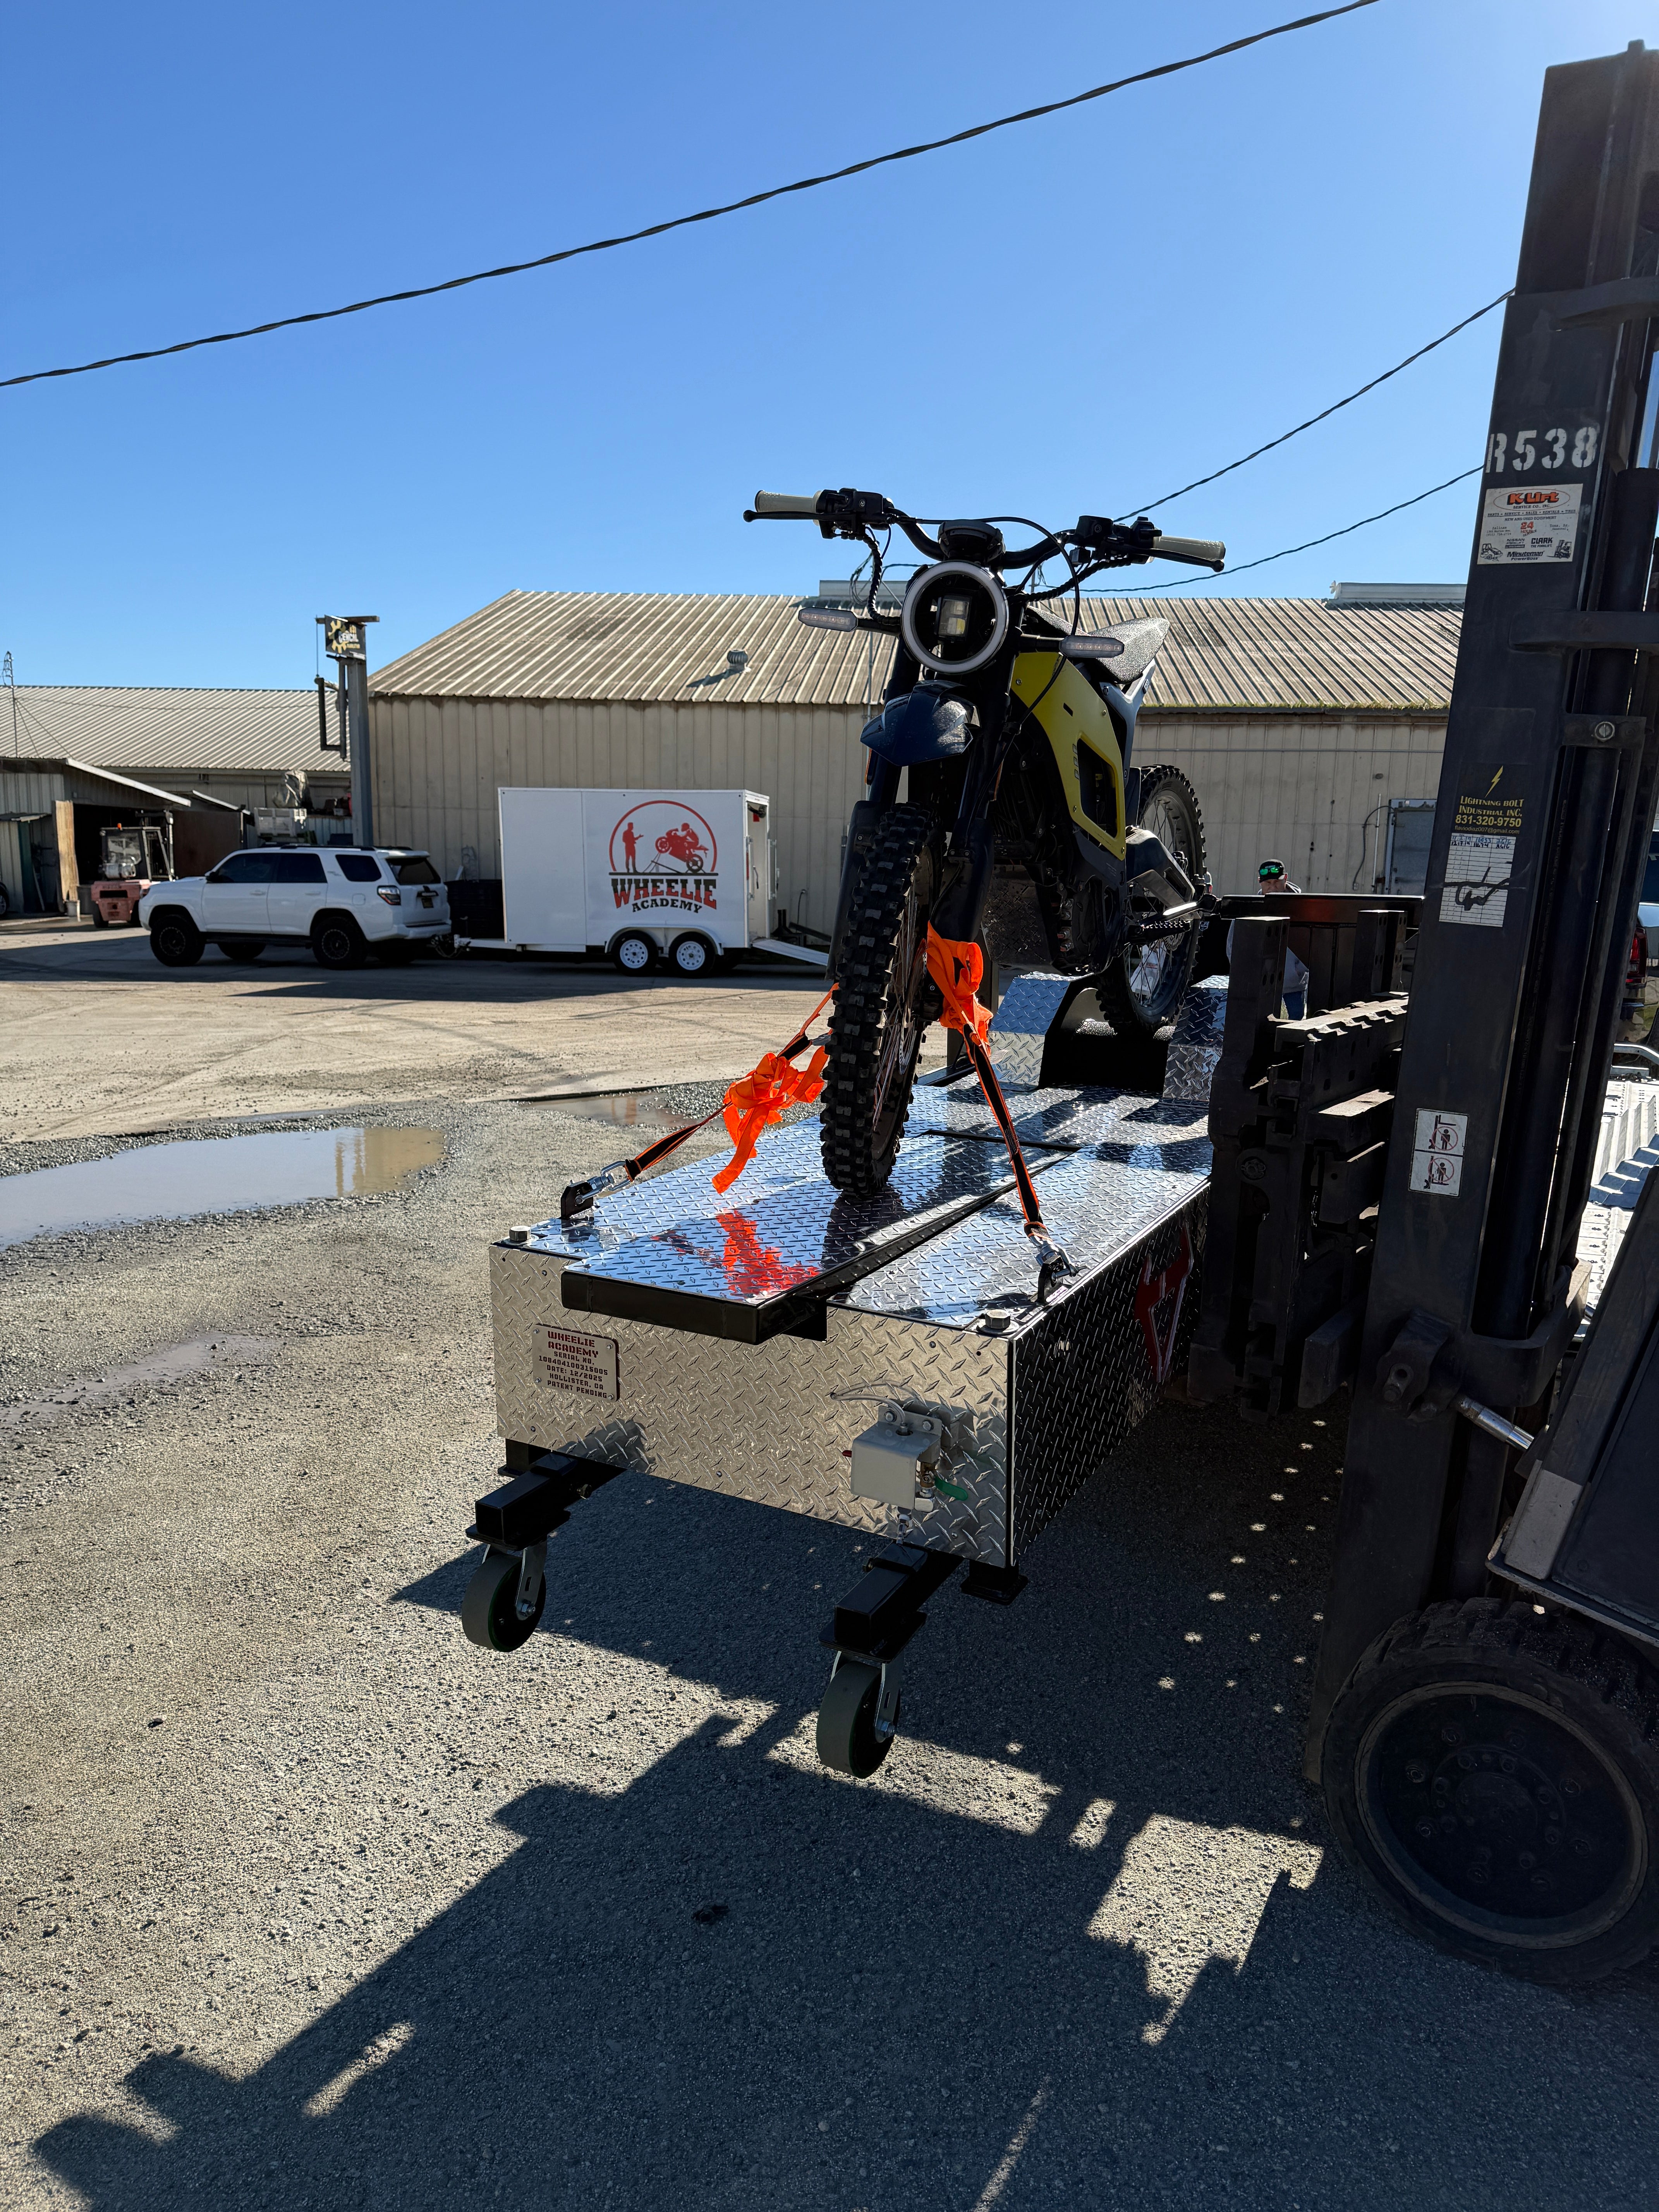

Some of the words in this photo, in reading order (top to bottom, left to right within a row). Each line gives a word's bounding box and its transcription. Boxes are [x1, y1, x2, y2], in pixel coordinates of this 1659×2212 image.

[1485, 427, 1597, 473] R538
[1507, 493, 1524, 505] K
[1520, 521, 1534, 529] 24
[1460, 796, 1501, 806] LIGHTNING
[1503, 799, 1525, 807] BOLT
[1459, 805, 1504, 816] INDUSTRIAL
[1506, 808, 1522, 817] INC.
[1455, 814, 1522, 827] 831-320-9750
[1455, 825, 1520, 834] flaviodiaz007@gmail.com
[611, 878, 717, 910] WHEELIE
[632, 898, 703, 914] ACADEMY
[548, 1331, 595, 1348] WHEELIE
[548, 1341, 599, 1358] ACADEMY
[554, 1351, 580, 1362] SERIAL
[539, 1355, 608, 1375] 108404100315005
[547, 1365, 567, 1374] DATE:
[570, 1370, 603, 1382] 12/2025
[547, 1380, 573, 1391] PATENT
[576, 1387, 607, 1399] PENDING
